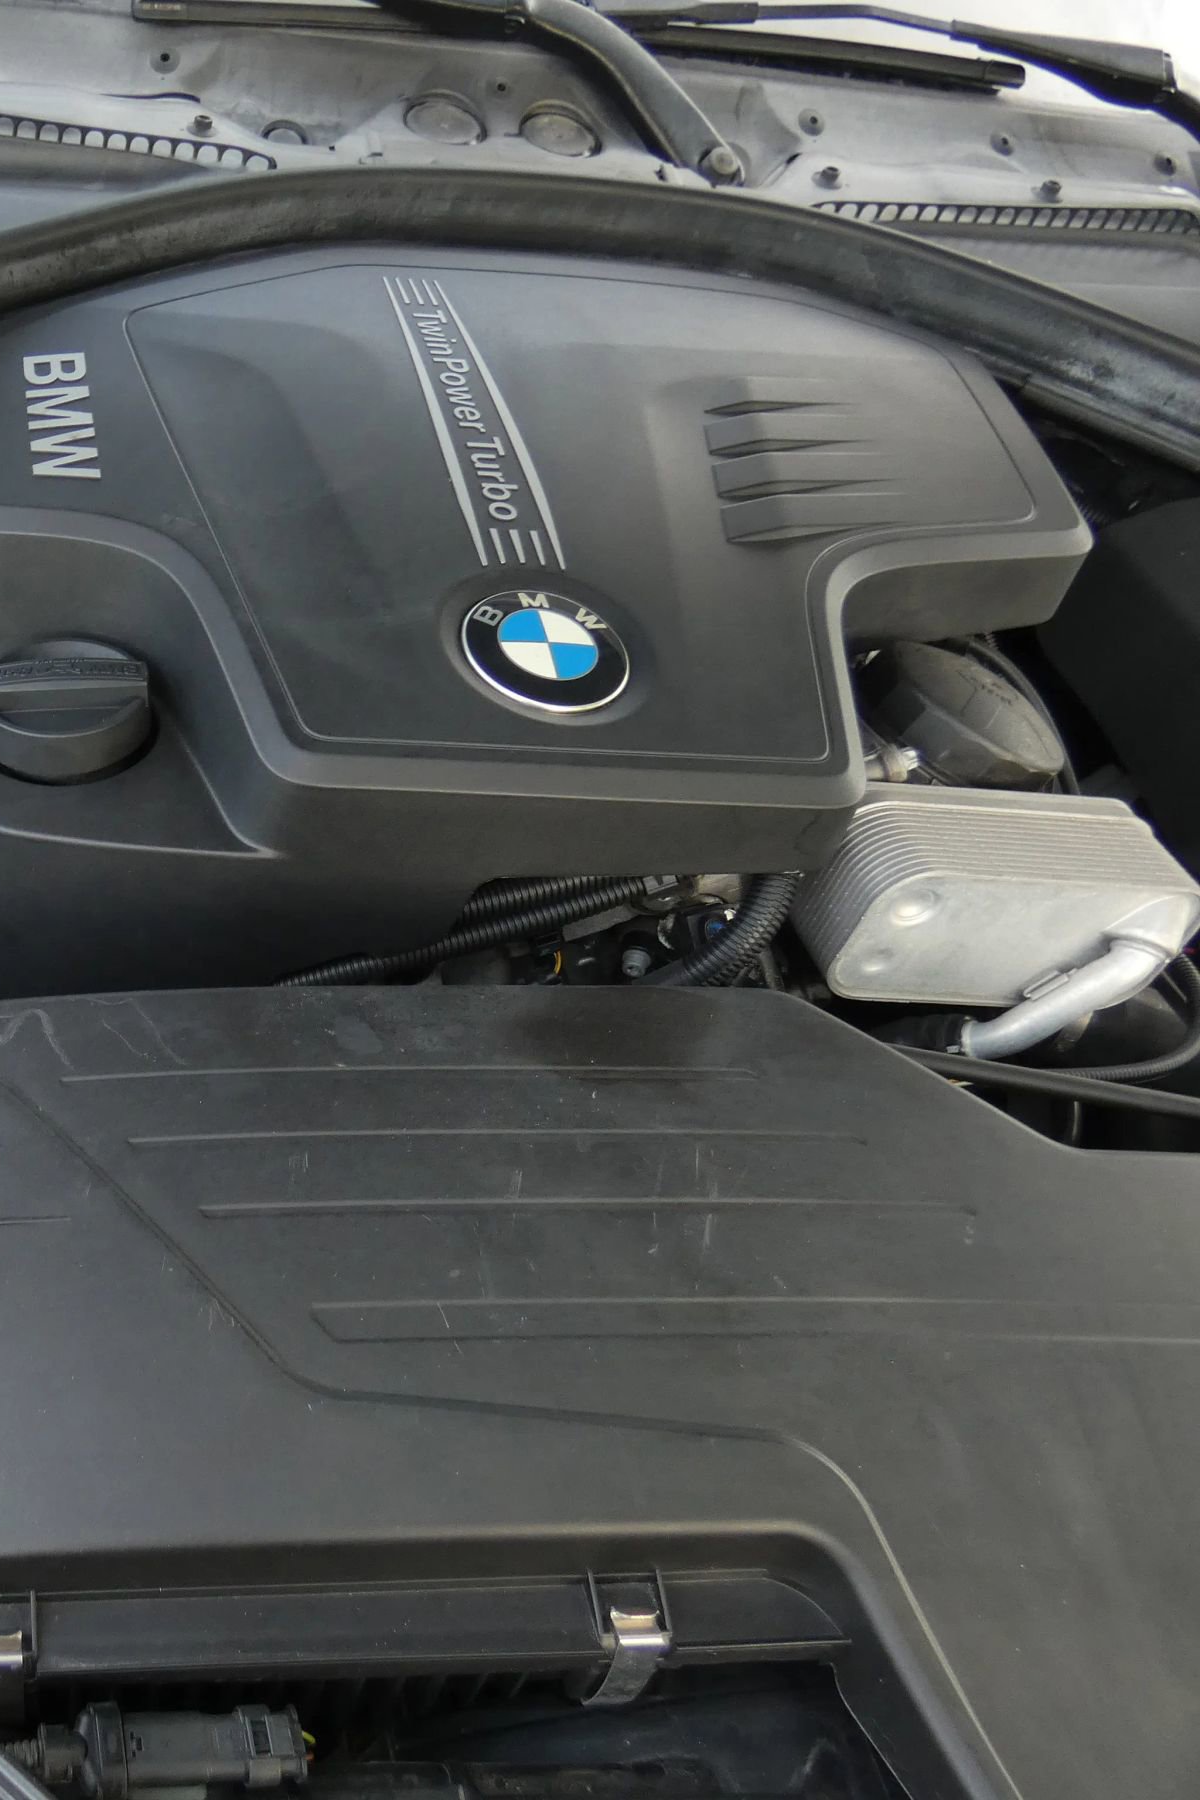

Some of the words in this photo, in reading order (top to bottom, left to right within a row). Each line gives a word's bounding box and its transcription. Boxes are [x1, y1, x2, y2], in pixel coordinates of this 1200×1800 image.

[22, 351, 102, 479] BMW
[412, 308, 487, 434] TwinPower
[466, 436, 520, 522] Turbo
[472, 592, 608, 632] BMW
